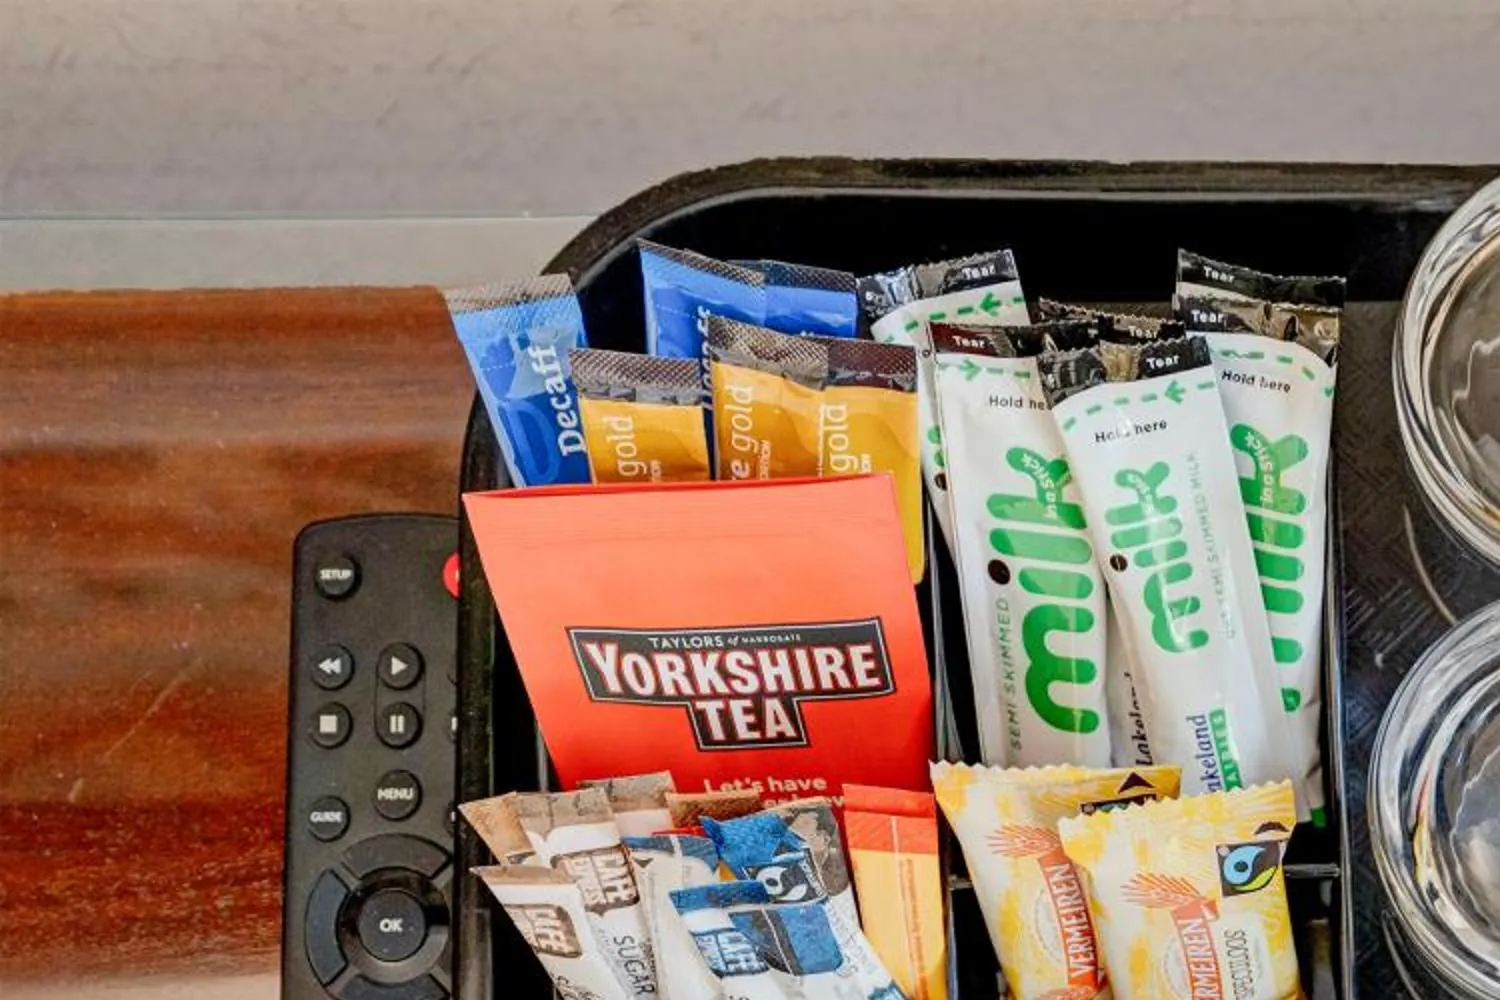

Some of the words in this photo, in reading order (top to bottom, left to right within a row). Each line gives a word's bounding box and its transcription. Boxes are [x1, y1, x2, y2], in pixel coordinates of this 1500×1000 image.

[962, 264, 996, 280] Tear
[1203, 265, 1236, 284] Tear
[1190, 309, 1225, 324] Tear
[1129, 325, 1158, 339] Tear
[952, 335, 985, 349] Tear
[1146, 355, 1180, 369] Tear
[1221, 369, 1256, 387] Hold
[1259, 376, 1291, 394] here
[528, 344, 588, 457] Decaff
[989, 394, 1024, 409] Hold
[724, 383, 759, 453] gold
[1134, 419, 1168, 436] here
[602, 414, 648, 477] gold
[825, 402, 860, 472] gold
[319, 568, 353, 581] SETUP
[649, 634, 724, 649] TAYLORS
[995, 598, 1017, 694] SKIMMED
[583, 642, 882, 698] YORKSHIRE
[694, 698, 799, 741] TEA
[1007, 702, 1023, 751] SEMI
[1185, 714, 1223, 793] akeland
[703, 777, 765, 793] Let's
[767, 775, 828, 793] have
[376, 787, 414, 801] MENU
[309, 810, 343, 823] GUIDE
[379, 917, 404, 933] OK
[1048, 863, 1097, 979] VERMEIREN
[613, 935, 656, 996] SUGAR
